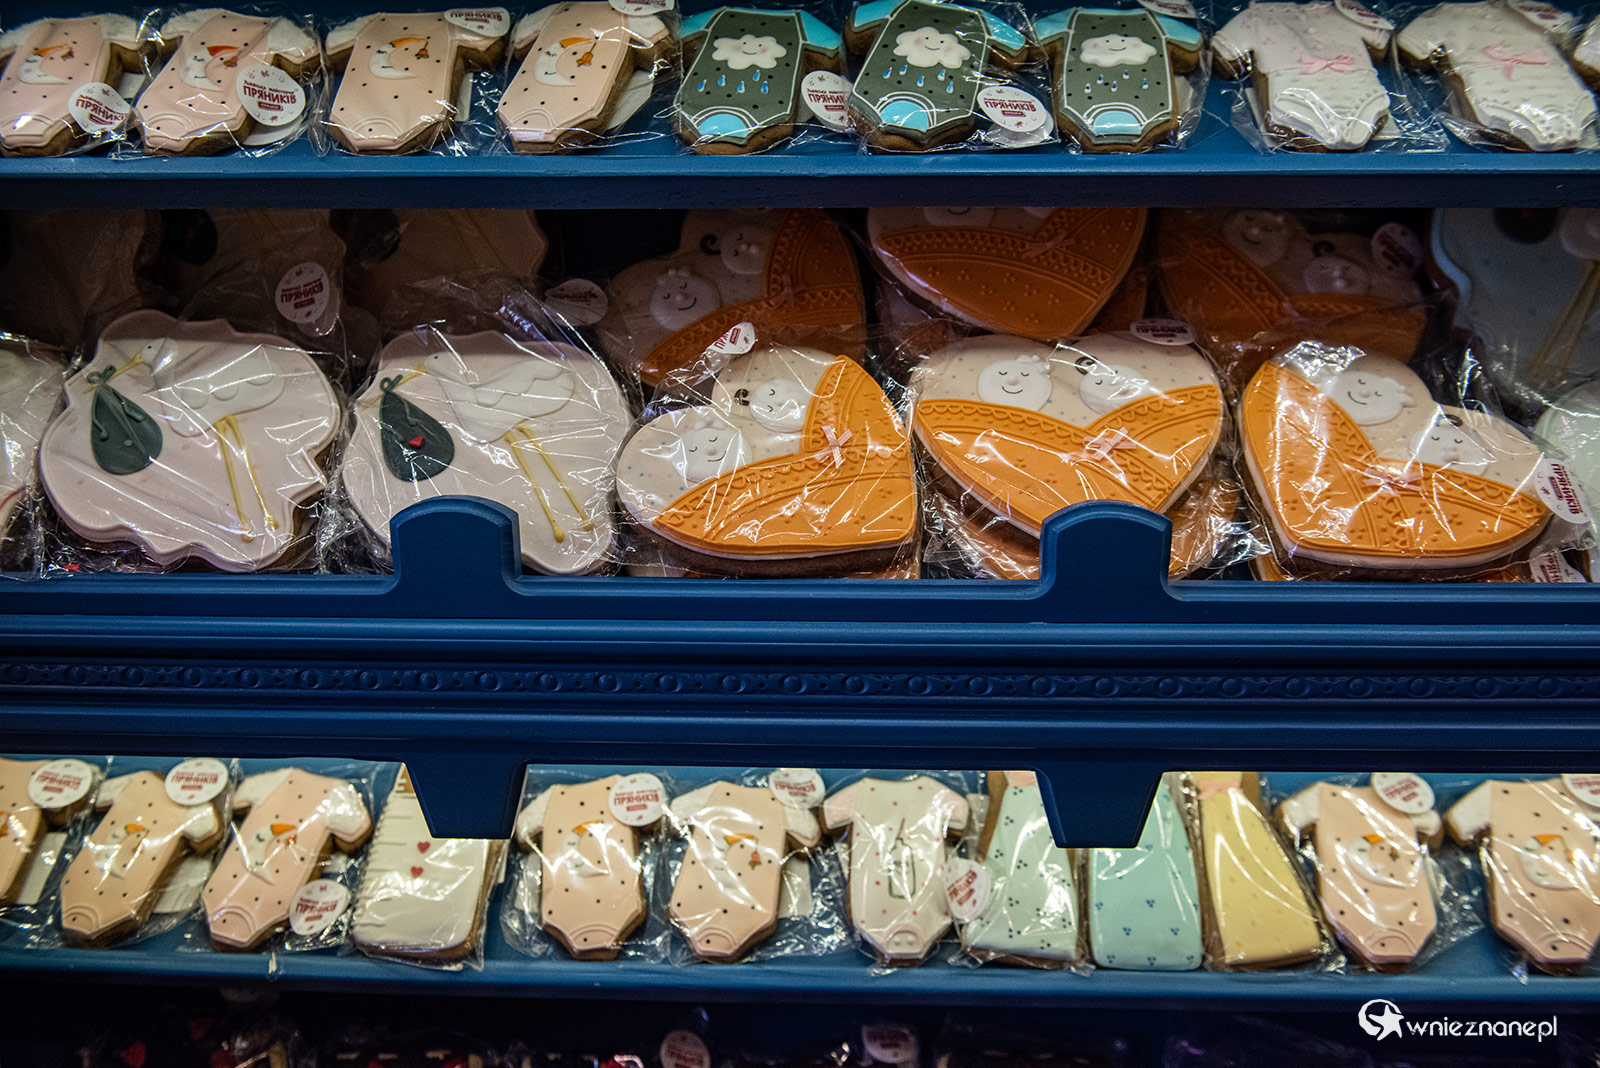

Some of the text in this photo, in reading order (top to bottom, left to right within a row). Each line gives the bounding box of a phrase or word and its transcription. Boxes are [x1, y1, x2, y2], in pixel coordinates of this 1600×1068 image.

[243, 85, 297, 104] ПРЯНИКІВ
[75, 98, 125, 121] ПРЯНИКІ
[984, 101, 1037, 112] ПРЯНИКІВ
[280, 281, 324, 304] ПРЯНИКІВ
[1550, 463, 1581, 515] ПРЯНИКІВ
